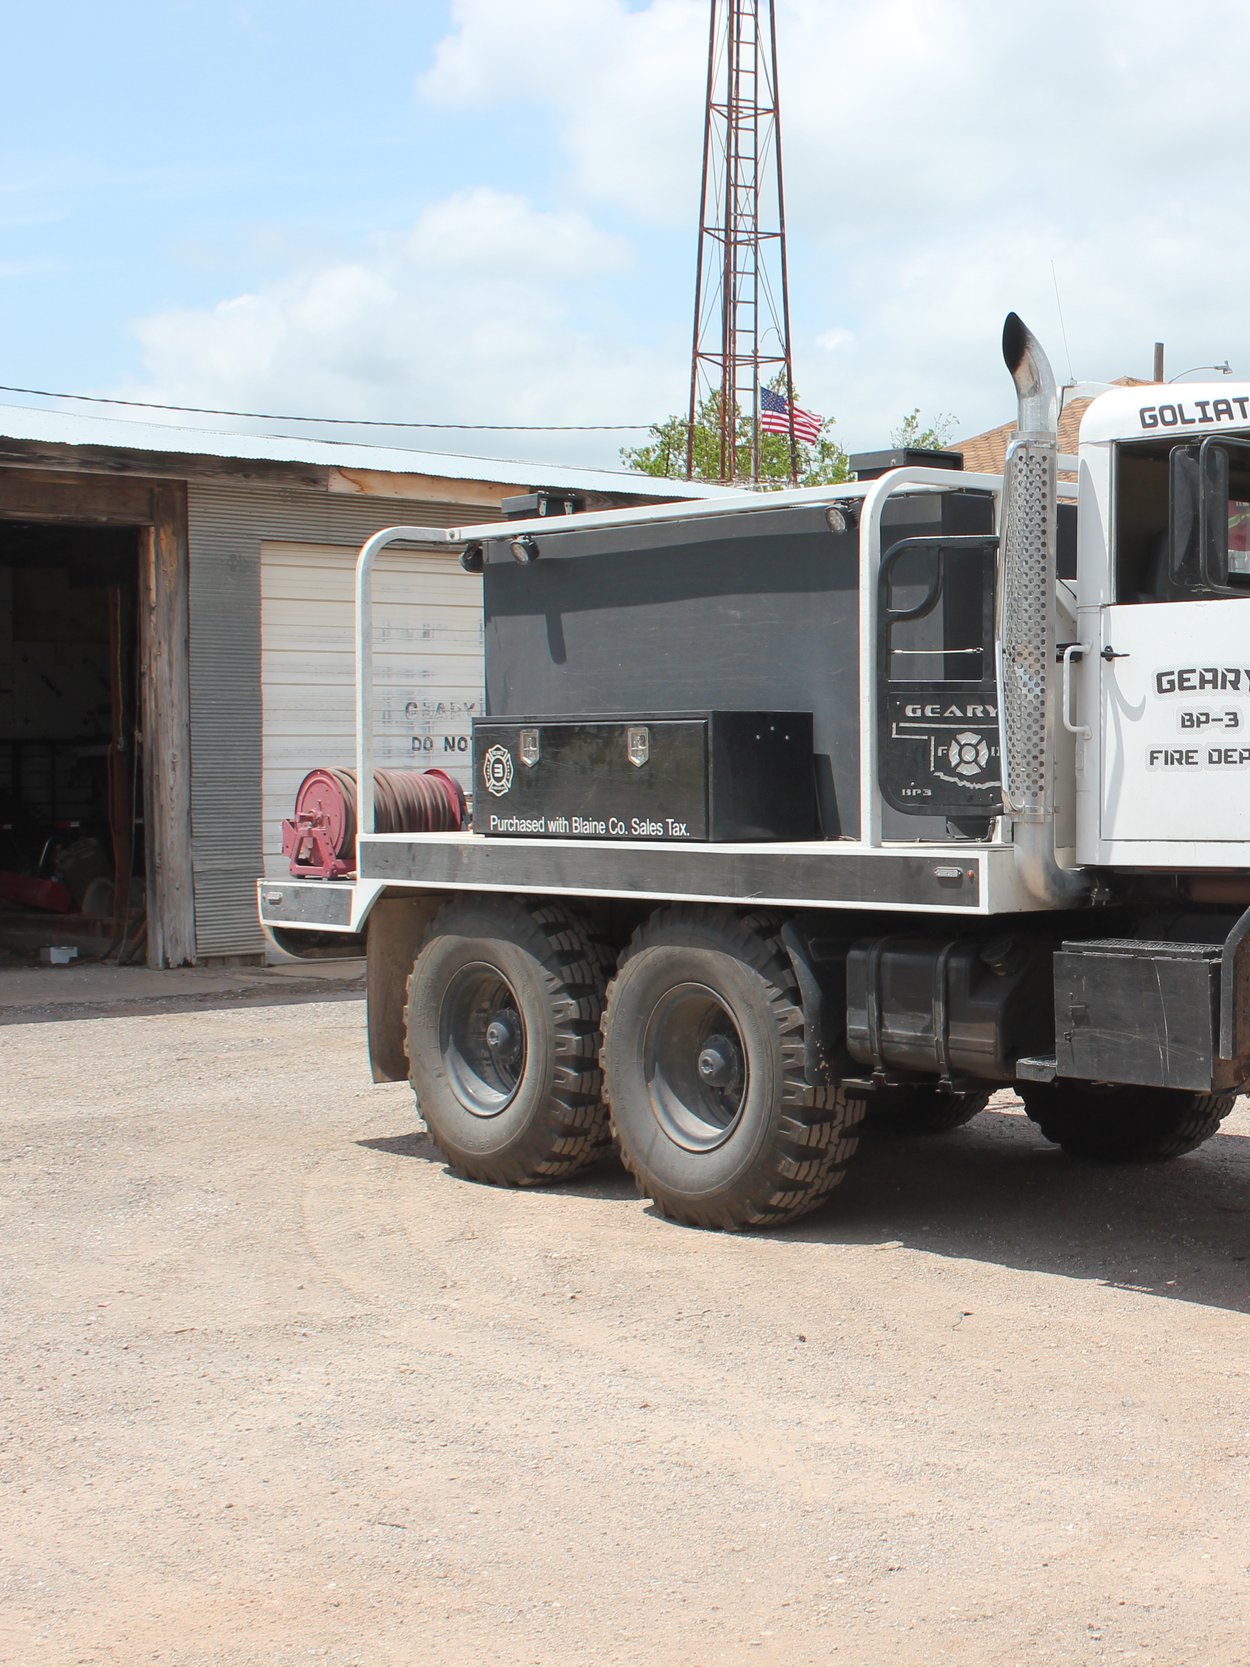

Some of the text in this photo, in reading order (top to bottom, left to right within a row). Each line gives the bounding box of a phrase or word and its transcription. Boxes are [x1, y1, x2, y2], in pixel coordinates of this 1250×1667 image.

[905, 705, 998, 717] GEARY
[1181, 711, 1239, 728] BP-3
[411, 736, 474, 752] DO NO
[1150, 750, 1198, 765] FIRE
[494, 763, 503, 777] 3
[902, 788, 932, 796] BP3
[490, 815, 690, 836] Purchased with Blaine Co. Sales Tax.
